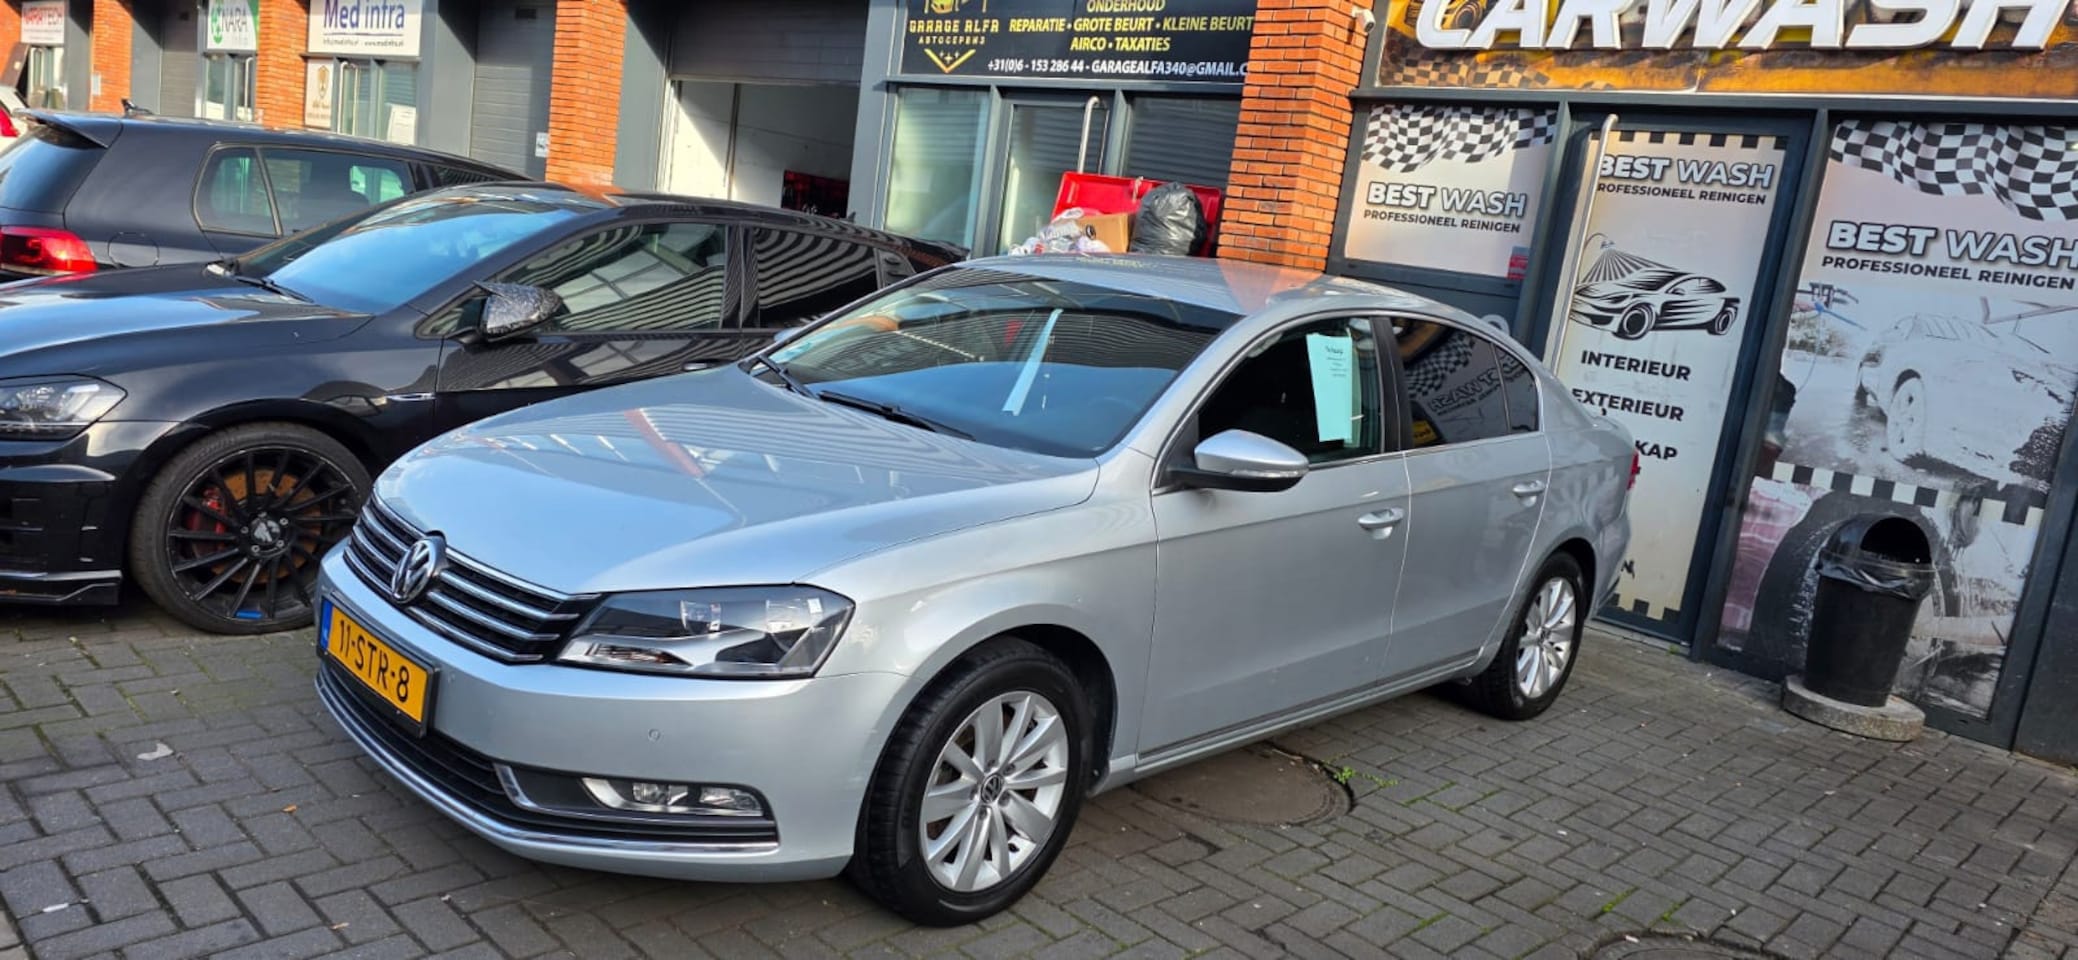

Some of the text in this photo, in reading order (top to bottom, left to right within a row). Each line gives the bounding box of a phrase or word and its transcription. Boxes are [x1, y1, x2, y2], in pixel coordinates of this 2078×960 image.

[324, 0, 404, 29] Med infra
[1086, 0, 1165, 12] ONDERHOUD
[910, 18, 999, 33] GARAGE ALFA
[1009, 15, 1254, 32] REPARATIE GROTE BEURT KLEINE BEURT
[1416, 0, 2070, 50] CARWASH
[1070, 37, 1171, 51] AIRCO TAXATIES
[988, 59, 1024, 73] +31(0)6
[1031, 60, 1048, 72] 153
[1050, 60, 1069, 72] 286
[1071, 60, 1084, 72] 44
[1600, 154, 1775, 190] BEST WASH
[1366, 181, 1528, 218] BEST WASH
[1597, 183, 1767, 205] ROFESSIONEEL REINIGEN
[1363, 209, 1521, 233] PROFESSIONEEL REINIGEN
[1827, 220, 2078, 269] BEST WASH
[1822, 255, 2075, 290] PROFESSIONEEL REINIGEN
[1580, 350, 1691, 381] INTERIEUR
[1572, 388, 1684, 422] EXTERIEUR
[339, 619, 410, 703] 11-STR-8
